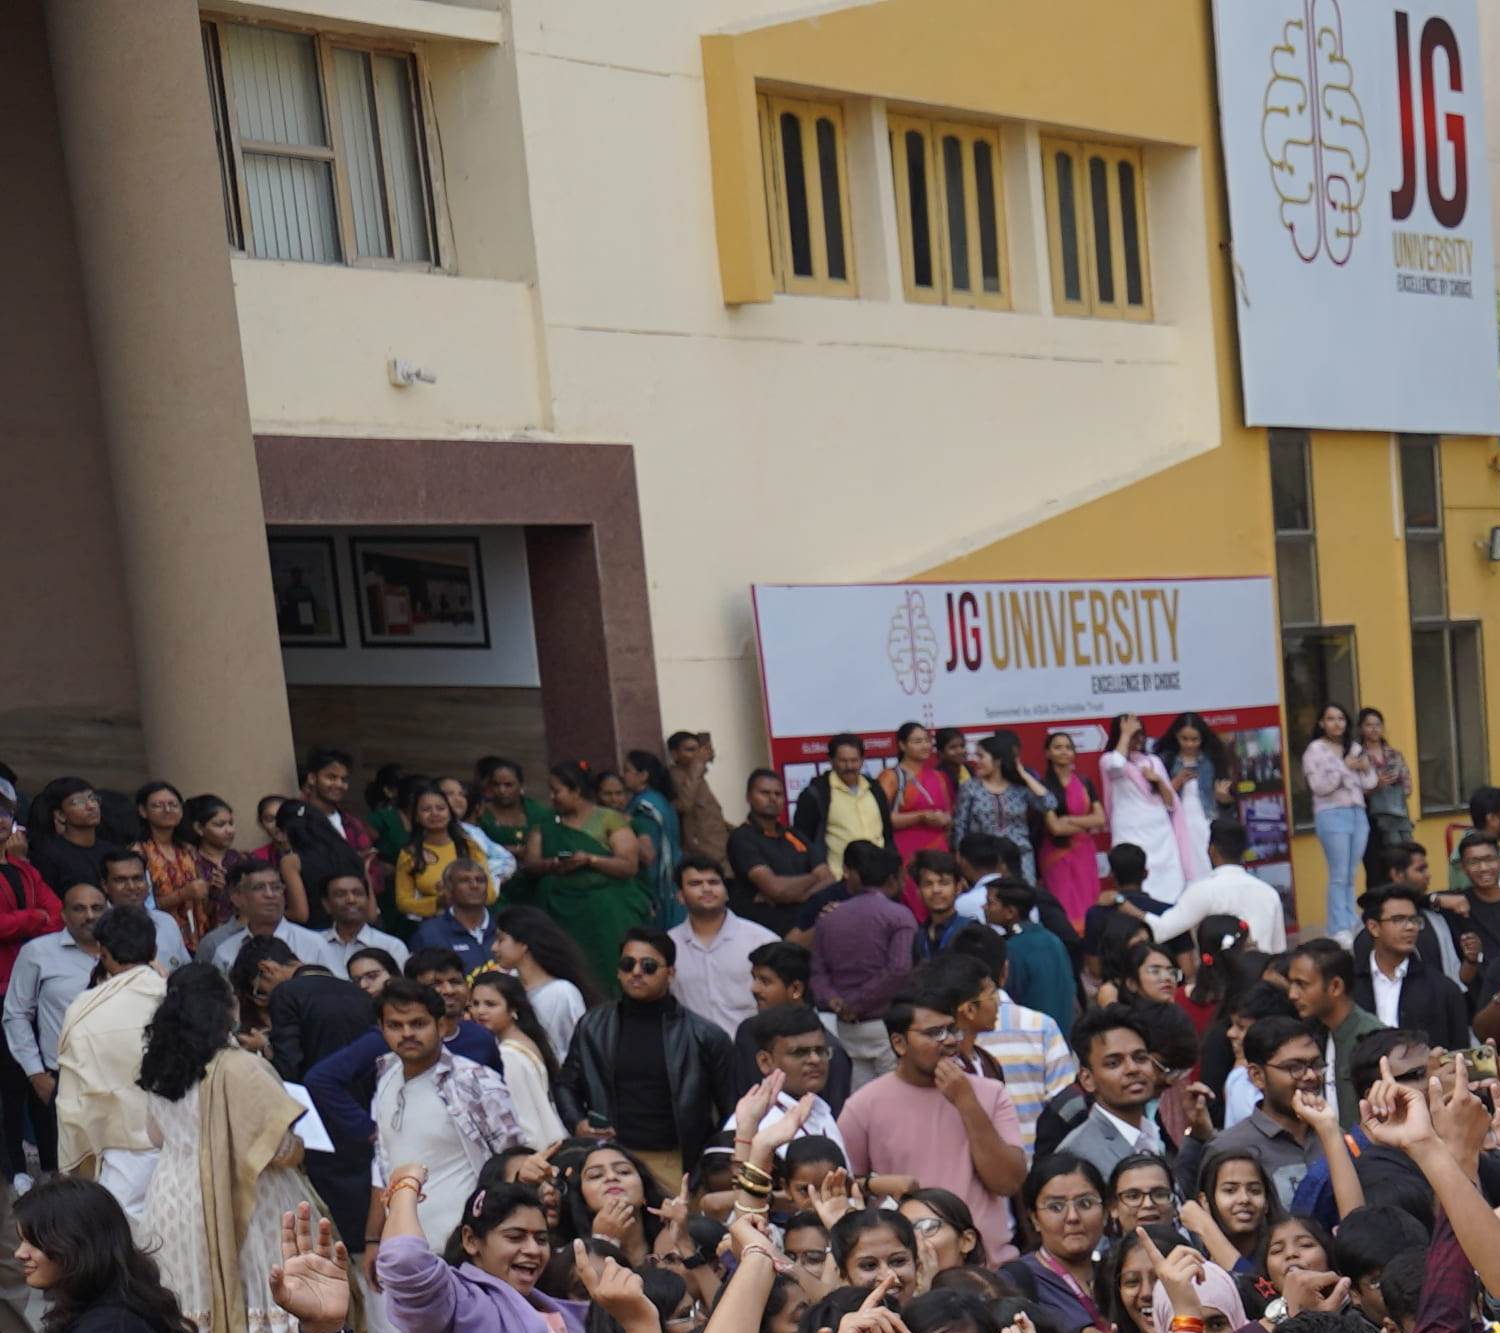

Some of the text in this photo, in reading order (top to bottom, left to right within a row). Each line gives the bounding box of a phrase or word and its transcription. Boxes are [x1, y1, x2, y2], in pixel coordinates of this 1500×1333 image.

[1391, 10, 1468, 228] JG
[1392, 231, 1473, 275] UNIVERSITY
[946, 588, 1180, 673] JG UNIVERSITY
